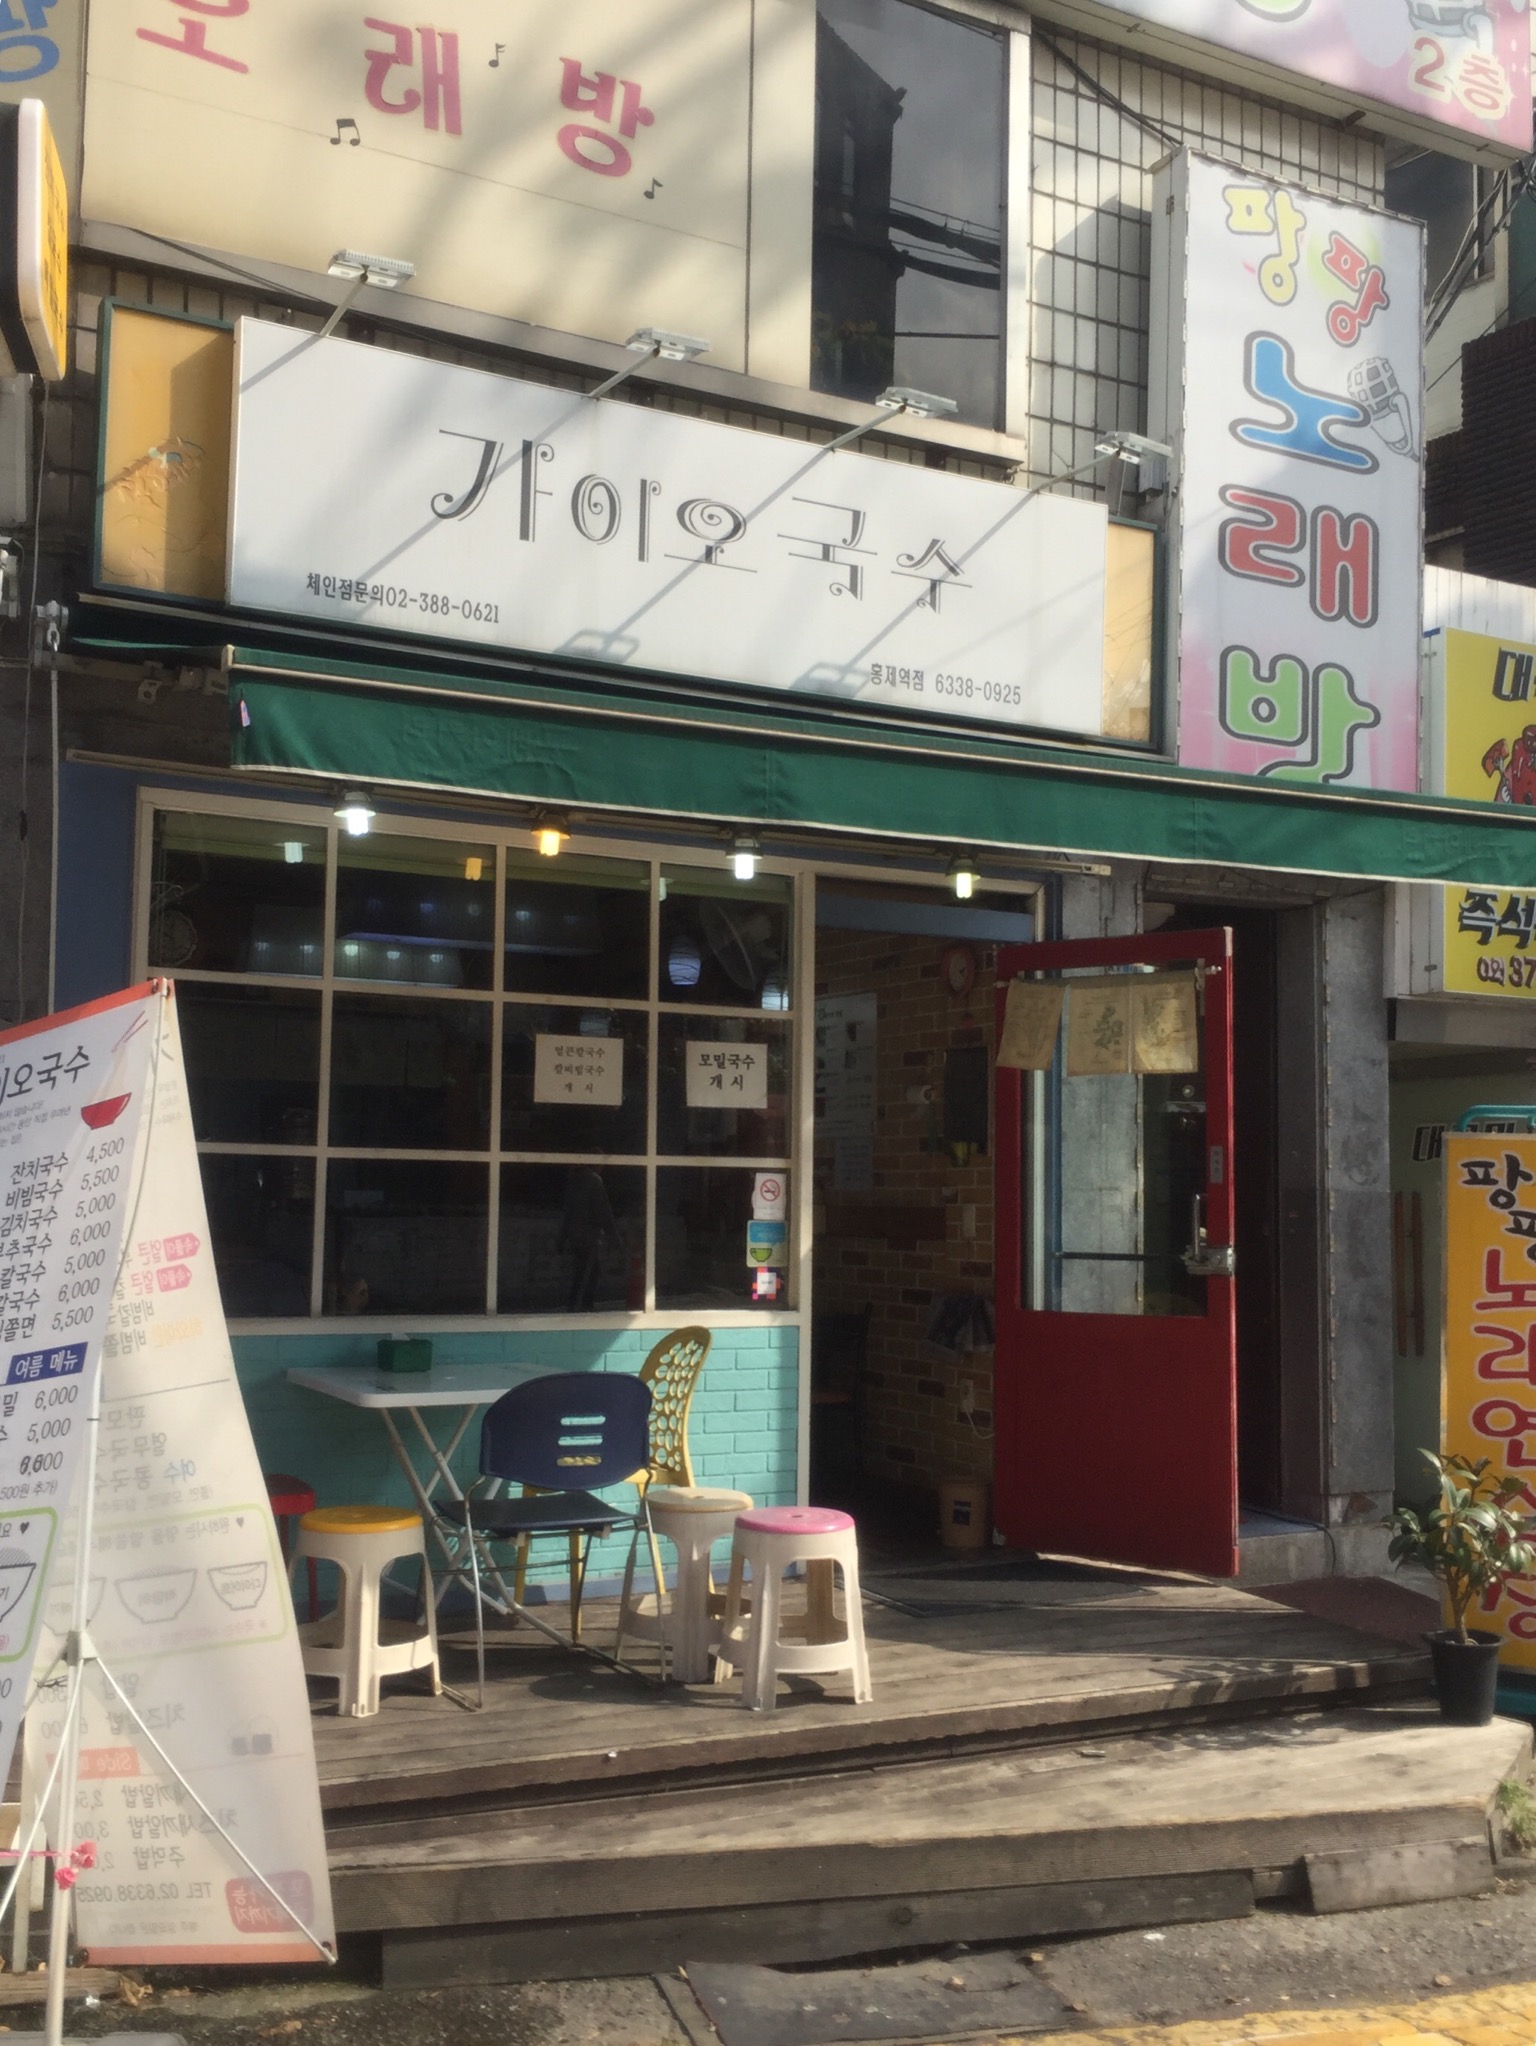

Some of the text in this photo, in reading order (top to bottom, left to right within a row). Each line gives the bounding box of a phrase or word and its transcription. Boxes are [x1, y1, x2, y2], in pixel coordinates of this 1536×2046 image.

[1413, 36, 1504, 111] 2층
[430, 428, 974, 615] 가이오국수
[870, 662, 1022, 706] 홍제역점 6338-0925
[698, 1052, 756, 1070] 모밀국수
[10, 1137, 125, 1185] 잔치국수 4,500
[5, 1165, 120, 1208] 비빔국수 5,500
[0, 1192, 116, 1238] 김치국수 5,000
[69, 1220, 112, 1247] 6,000
[64, 1249, 106, 1275] 5,000
[58, 1277, 100, 1303] 6,000
[51, 1305, 94, 1332] 5,500
[15, 1350, 78, 1380] 여름 메뉴
[34, 1385, 78, 1411] 6,000
[27, 1417, 71, 1444] 5,000
